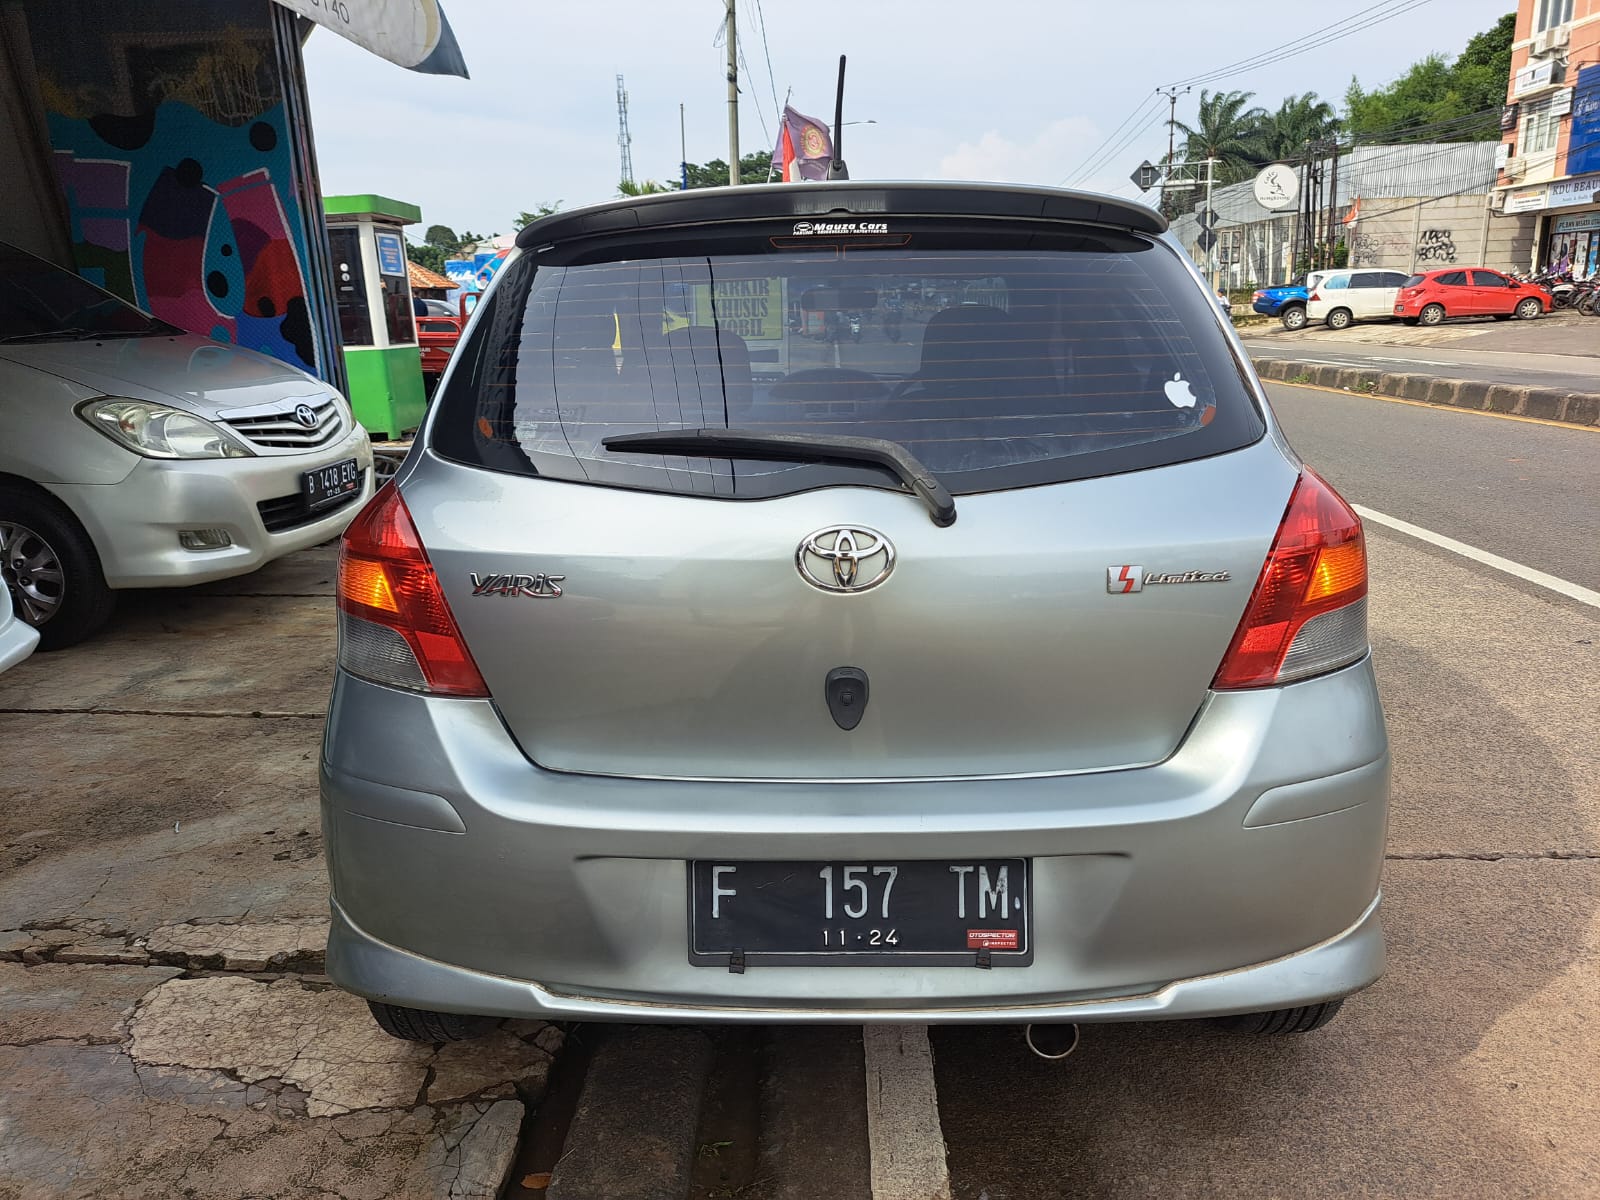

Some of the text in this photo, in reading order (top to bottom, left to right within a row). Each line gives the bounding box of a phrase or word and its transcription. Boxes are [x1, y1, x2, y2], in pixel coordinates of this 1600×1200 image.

[1552, 184, 1571, 195] KDU
[1573, 177, 1600, 192] BEAU
[814, 222, 888, 231] Mauza Cars
[309, 475, 314, 494] B
[320, 468, 338, 489] 1418
[1143, 571, 1231, 585] Limited
[712, 865, 1009, 919] F 157 TM
